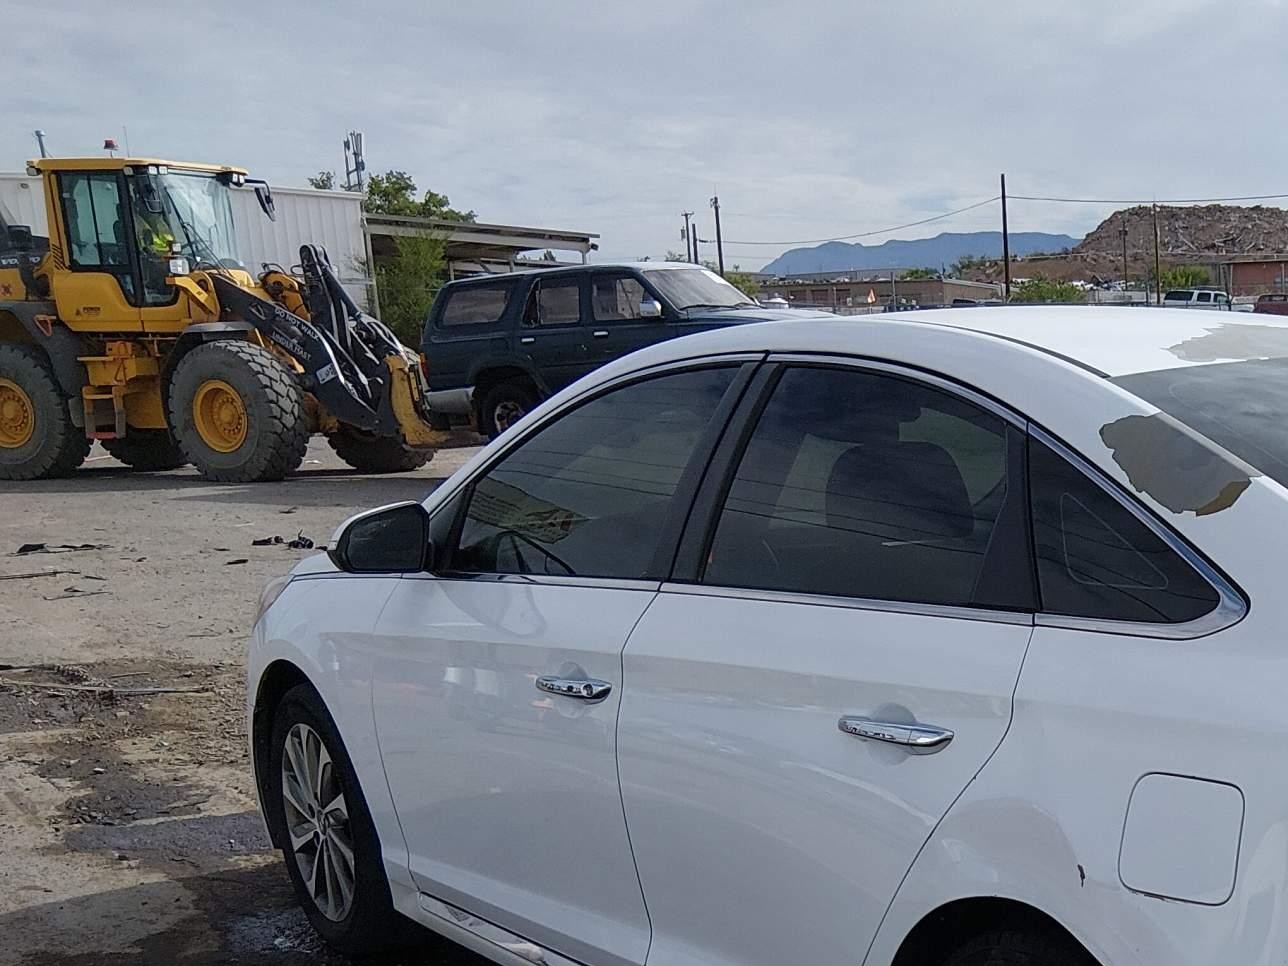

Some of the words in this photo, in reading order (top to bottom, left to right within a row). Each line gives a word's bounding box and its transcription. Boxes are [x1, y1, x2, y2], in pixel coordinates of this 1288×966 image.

[274, 307, 286, 318] DO
[286, 314, 300, 327] NOT
[301, 323, 320, 341] WALK
